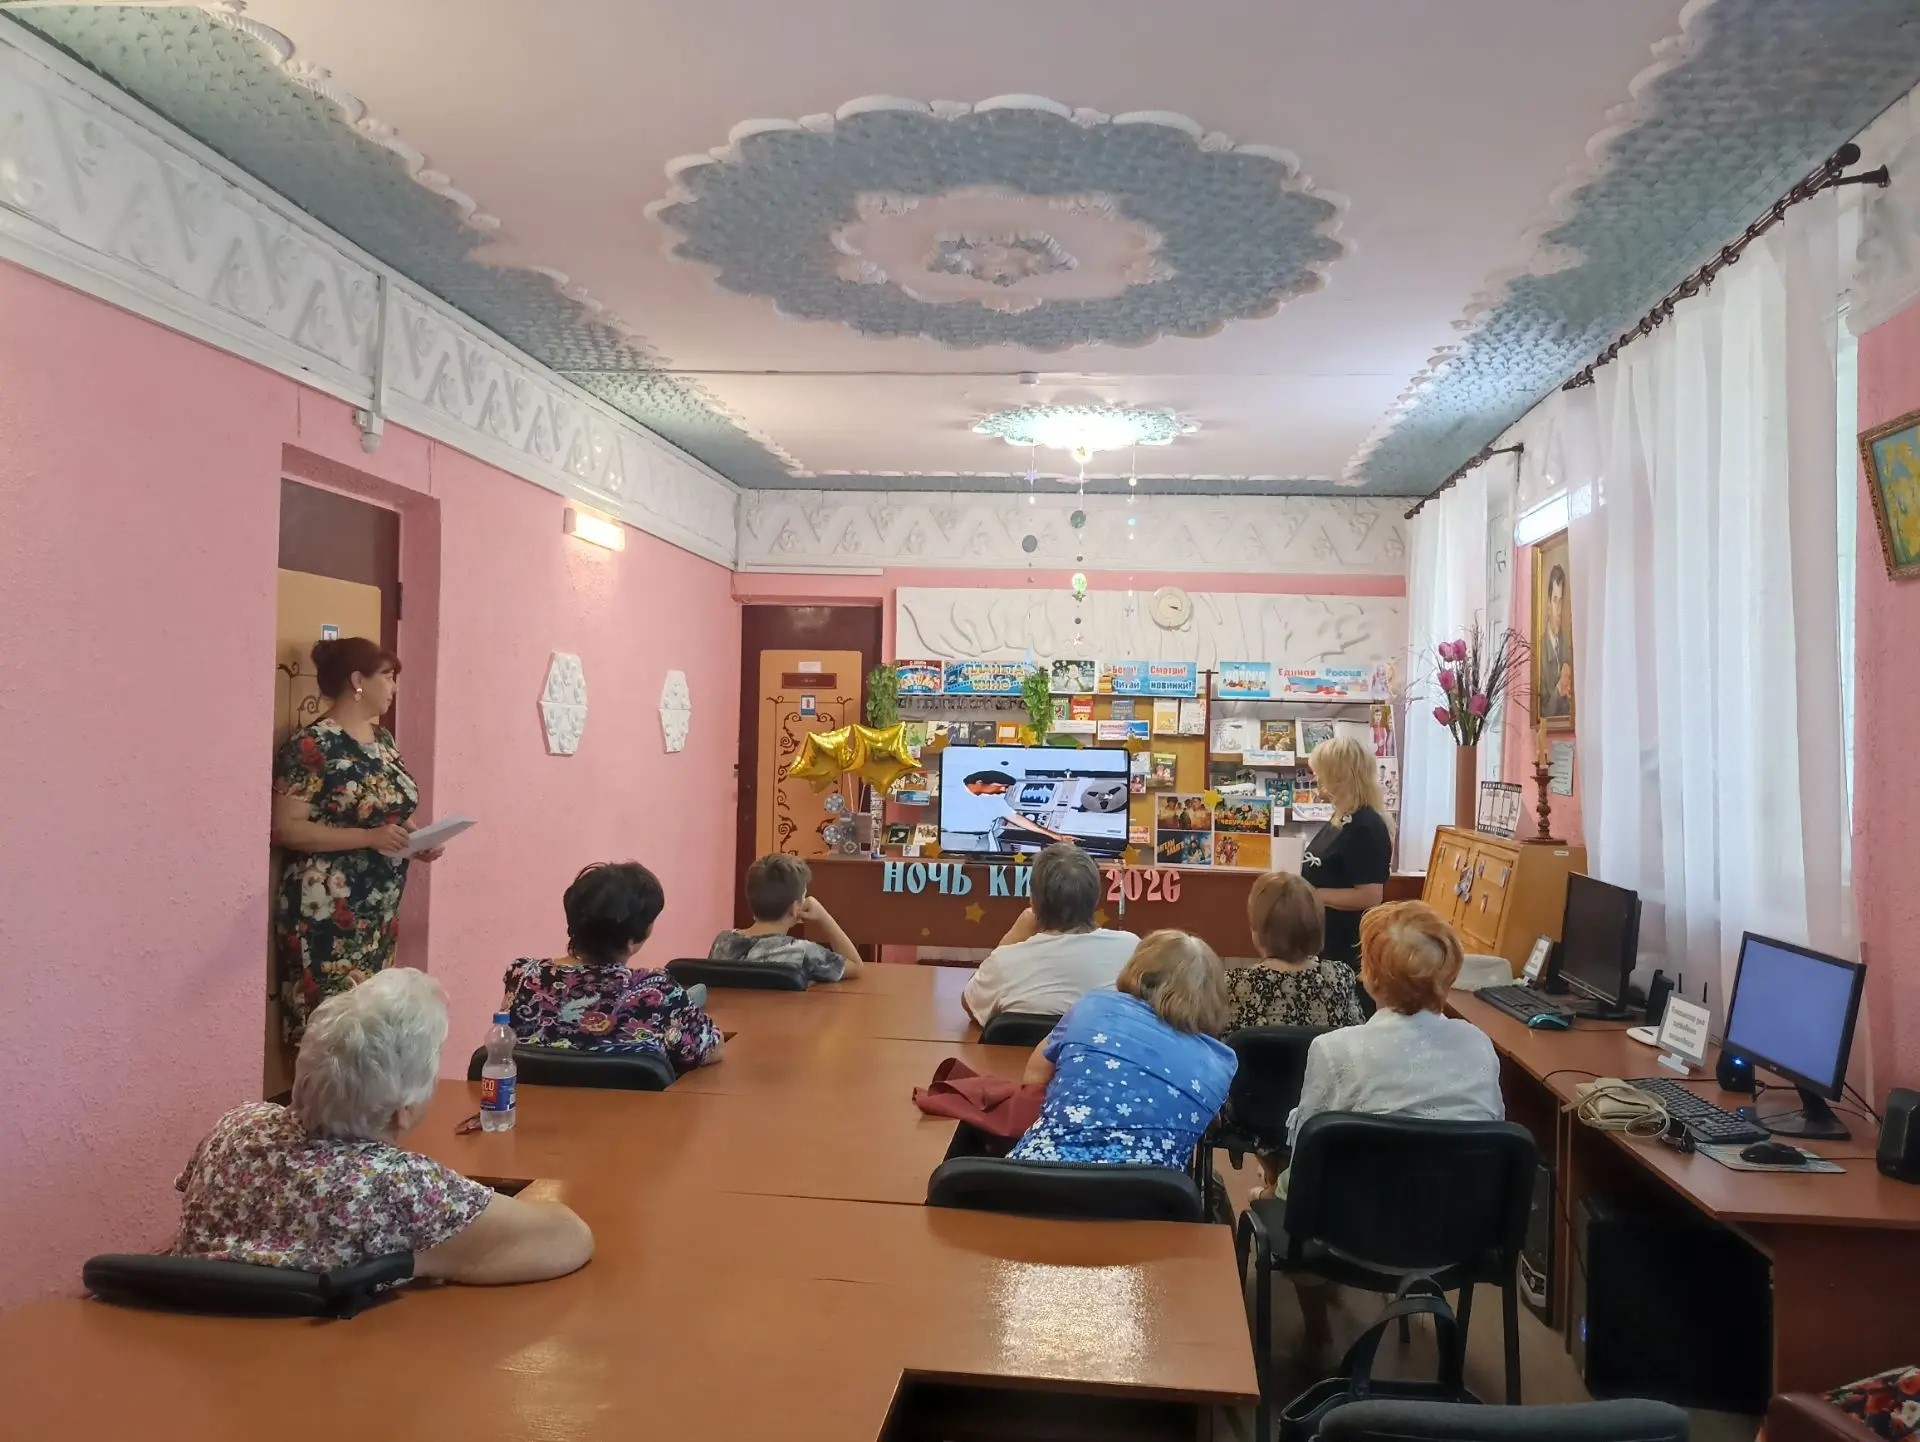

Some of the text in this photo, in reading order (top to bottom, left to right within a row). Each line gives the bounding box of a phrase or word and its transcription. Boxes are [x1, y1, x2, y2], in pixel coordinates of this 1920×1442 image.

[1150, 665, 1188, 676] Смотри!
[1278, 668, 1362, 677] Единая Россия
[973, 679, 1010, 690] КИНО
[1150, 681, 1193, 691] новинки!
[883, 861, 1181, 903] НОЧЬ КИ 2026
